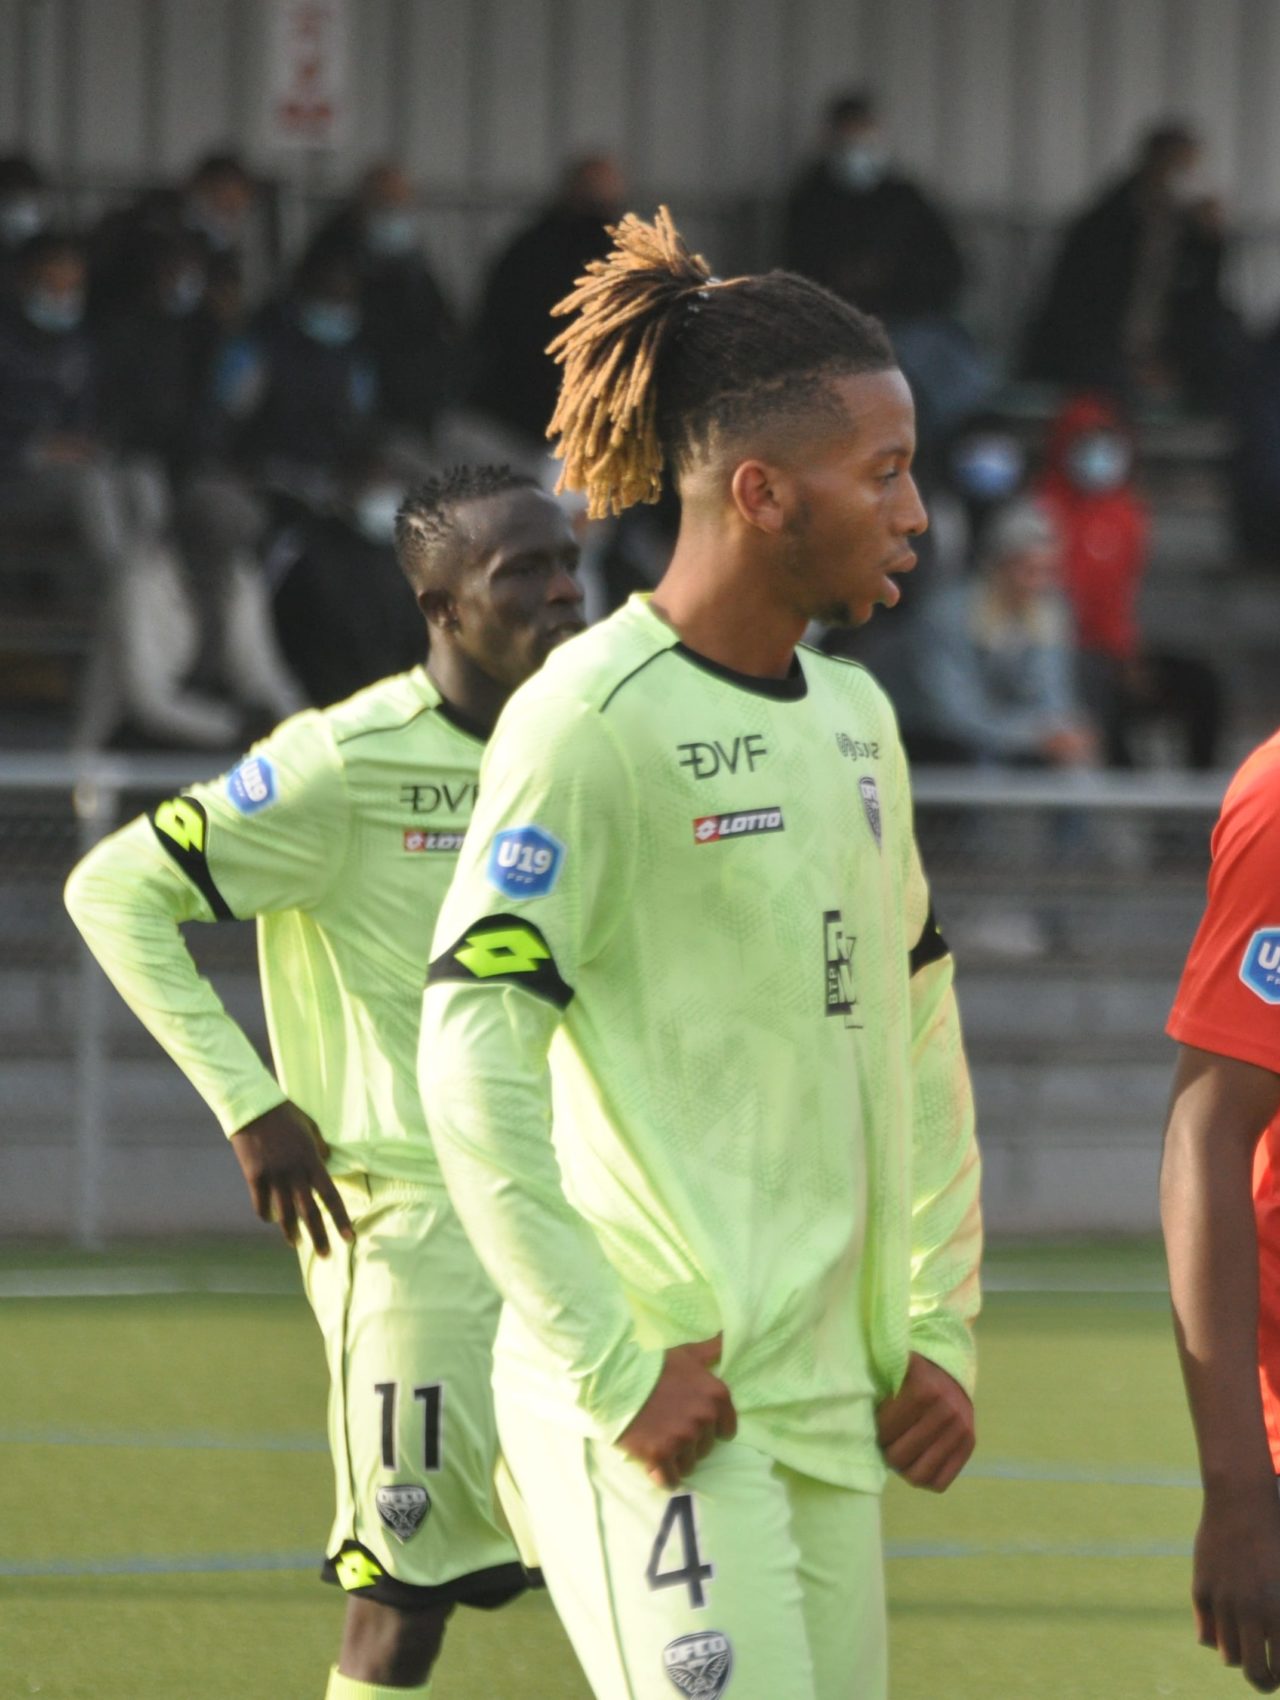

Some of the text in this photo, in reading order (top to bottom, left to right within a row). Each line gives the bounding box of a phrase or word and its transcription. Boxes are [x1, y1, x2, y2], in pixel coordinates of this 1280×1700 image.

[676, 733, 768, 781] DVF
[718, 811, 781, 835] LOTTO
[497, 840, 553, 875] U19
[374, 1381, 443, 1472] 11
[645, 1492, 716, 1611] 4
[664, 1636, 727, 1666] DFCO
